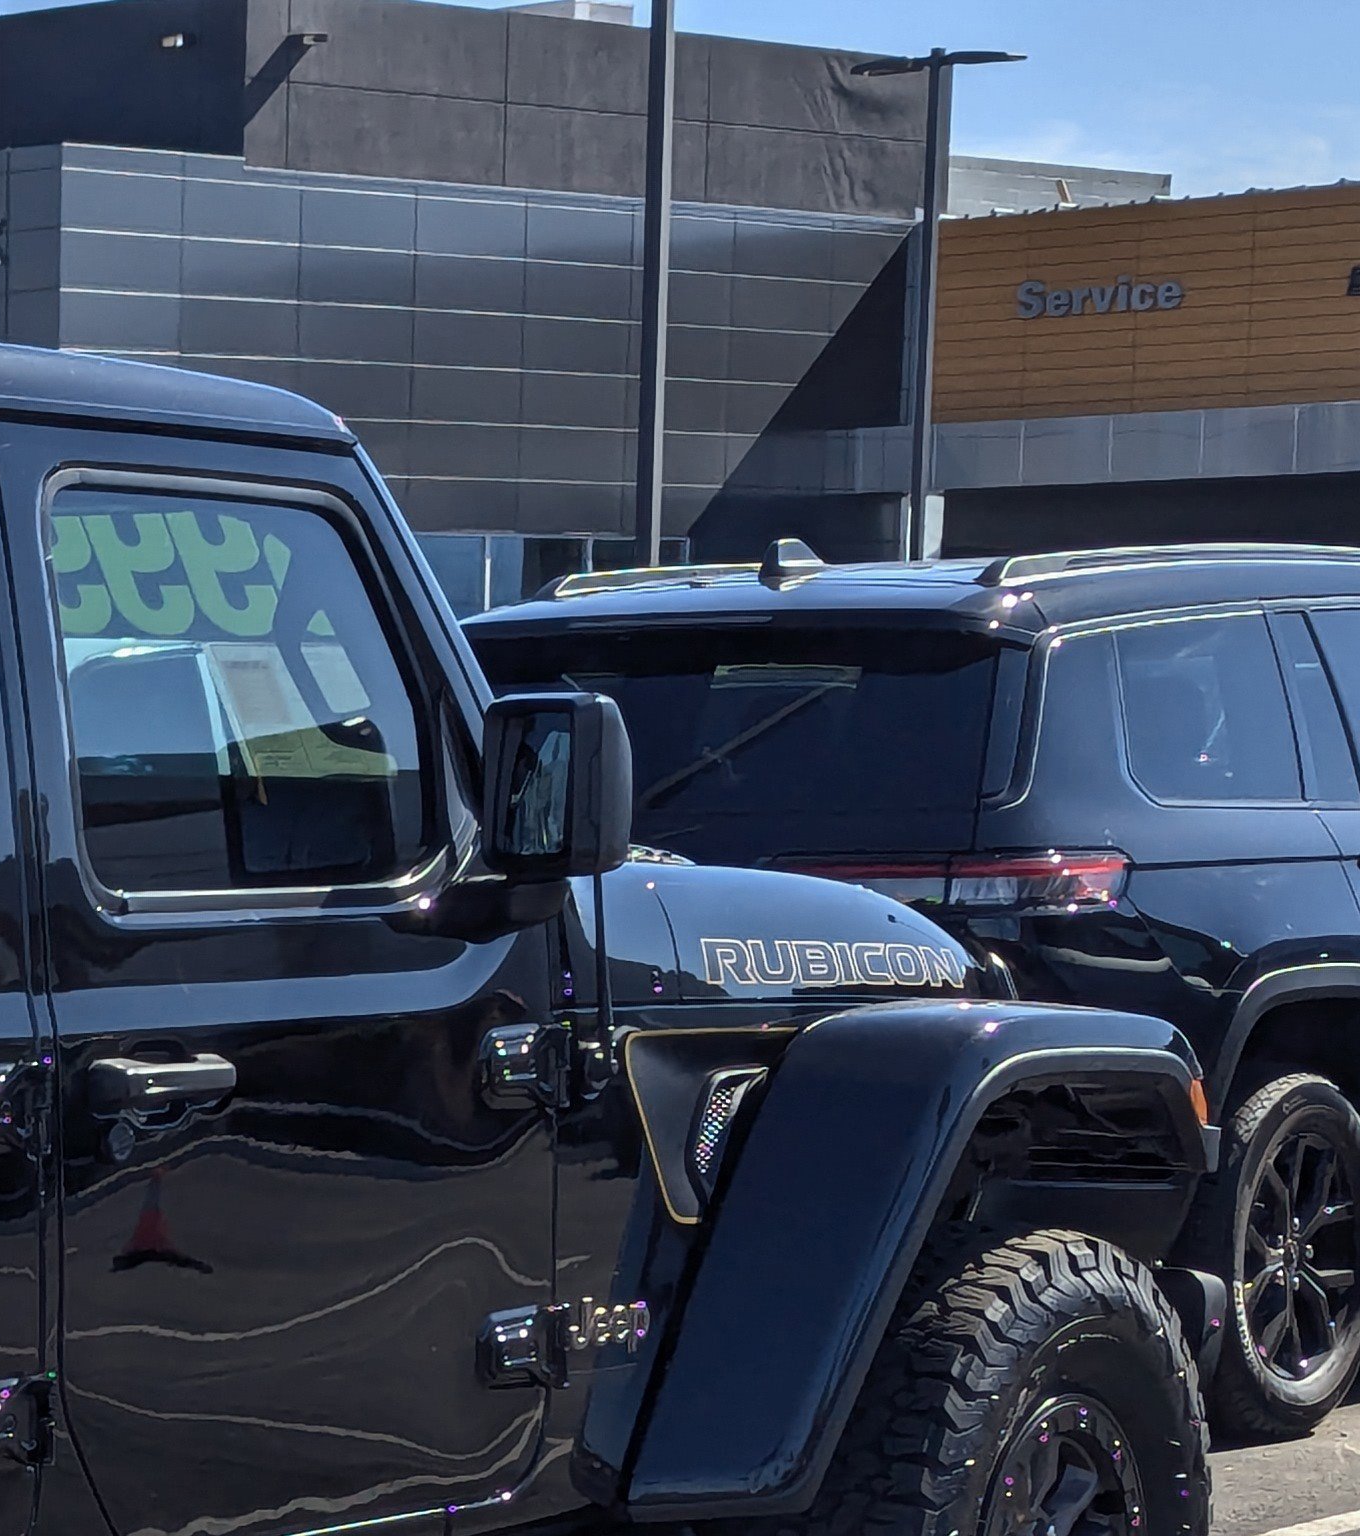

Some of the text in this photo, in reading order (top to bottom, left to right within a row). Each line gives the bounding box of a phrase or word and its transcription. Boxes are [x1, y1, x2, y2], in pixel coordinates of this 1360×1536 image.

[1016, 272, 1186, 320] Service
[700, 938, 965, 989] RUBICON
[568, 1296, 651, 1354] Jeep
